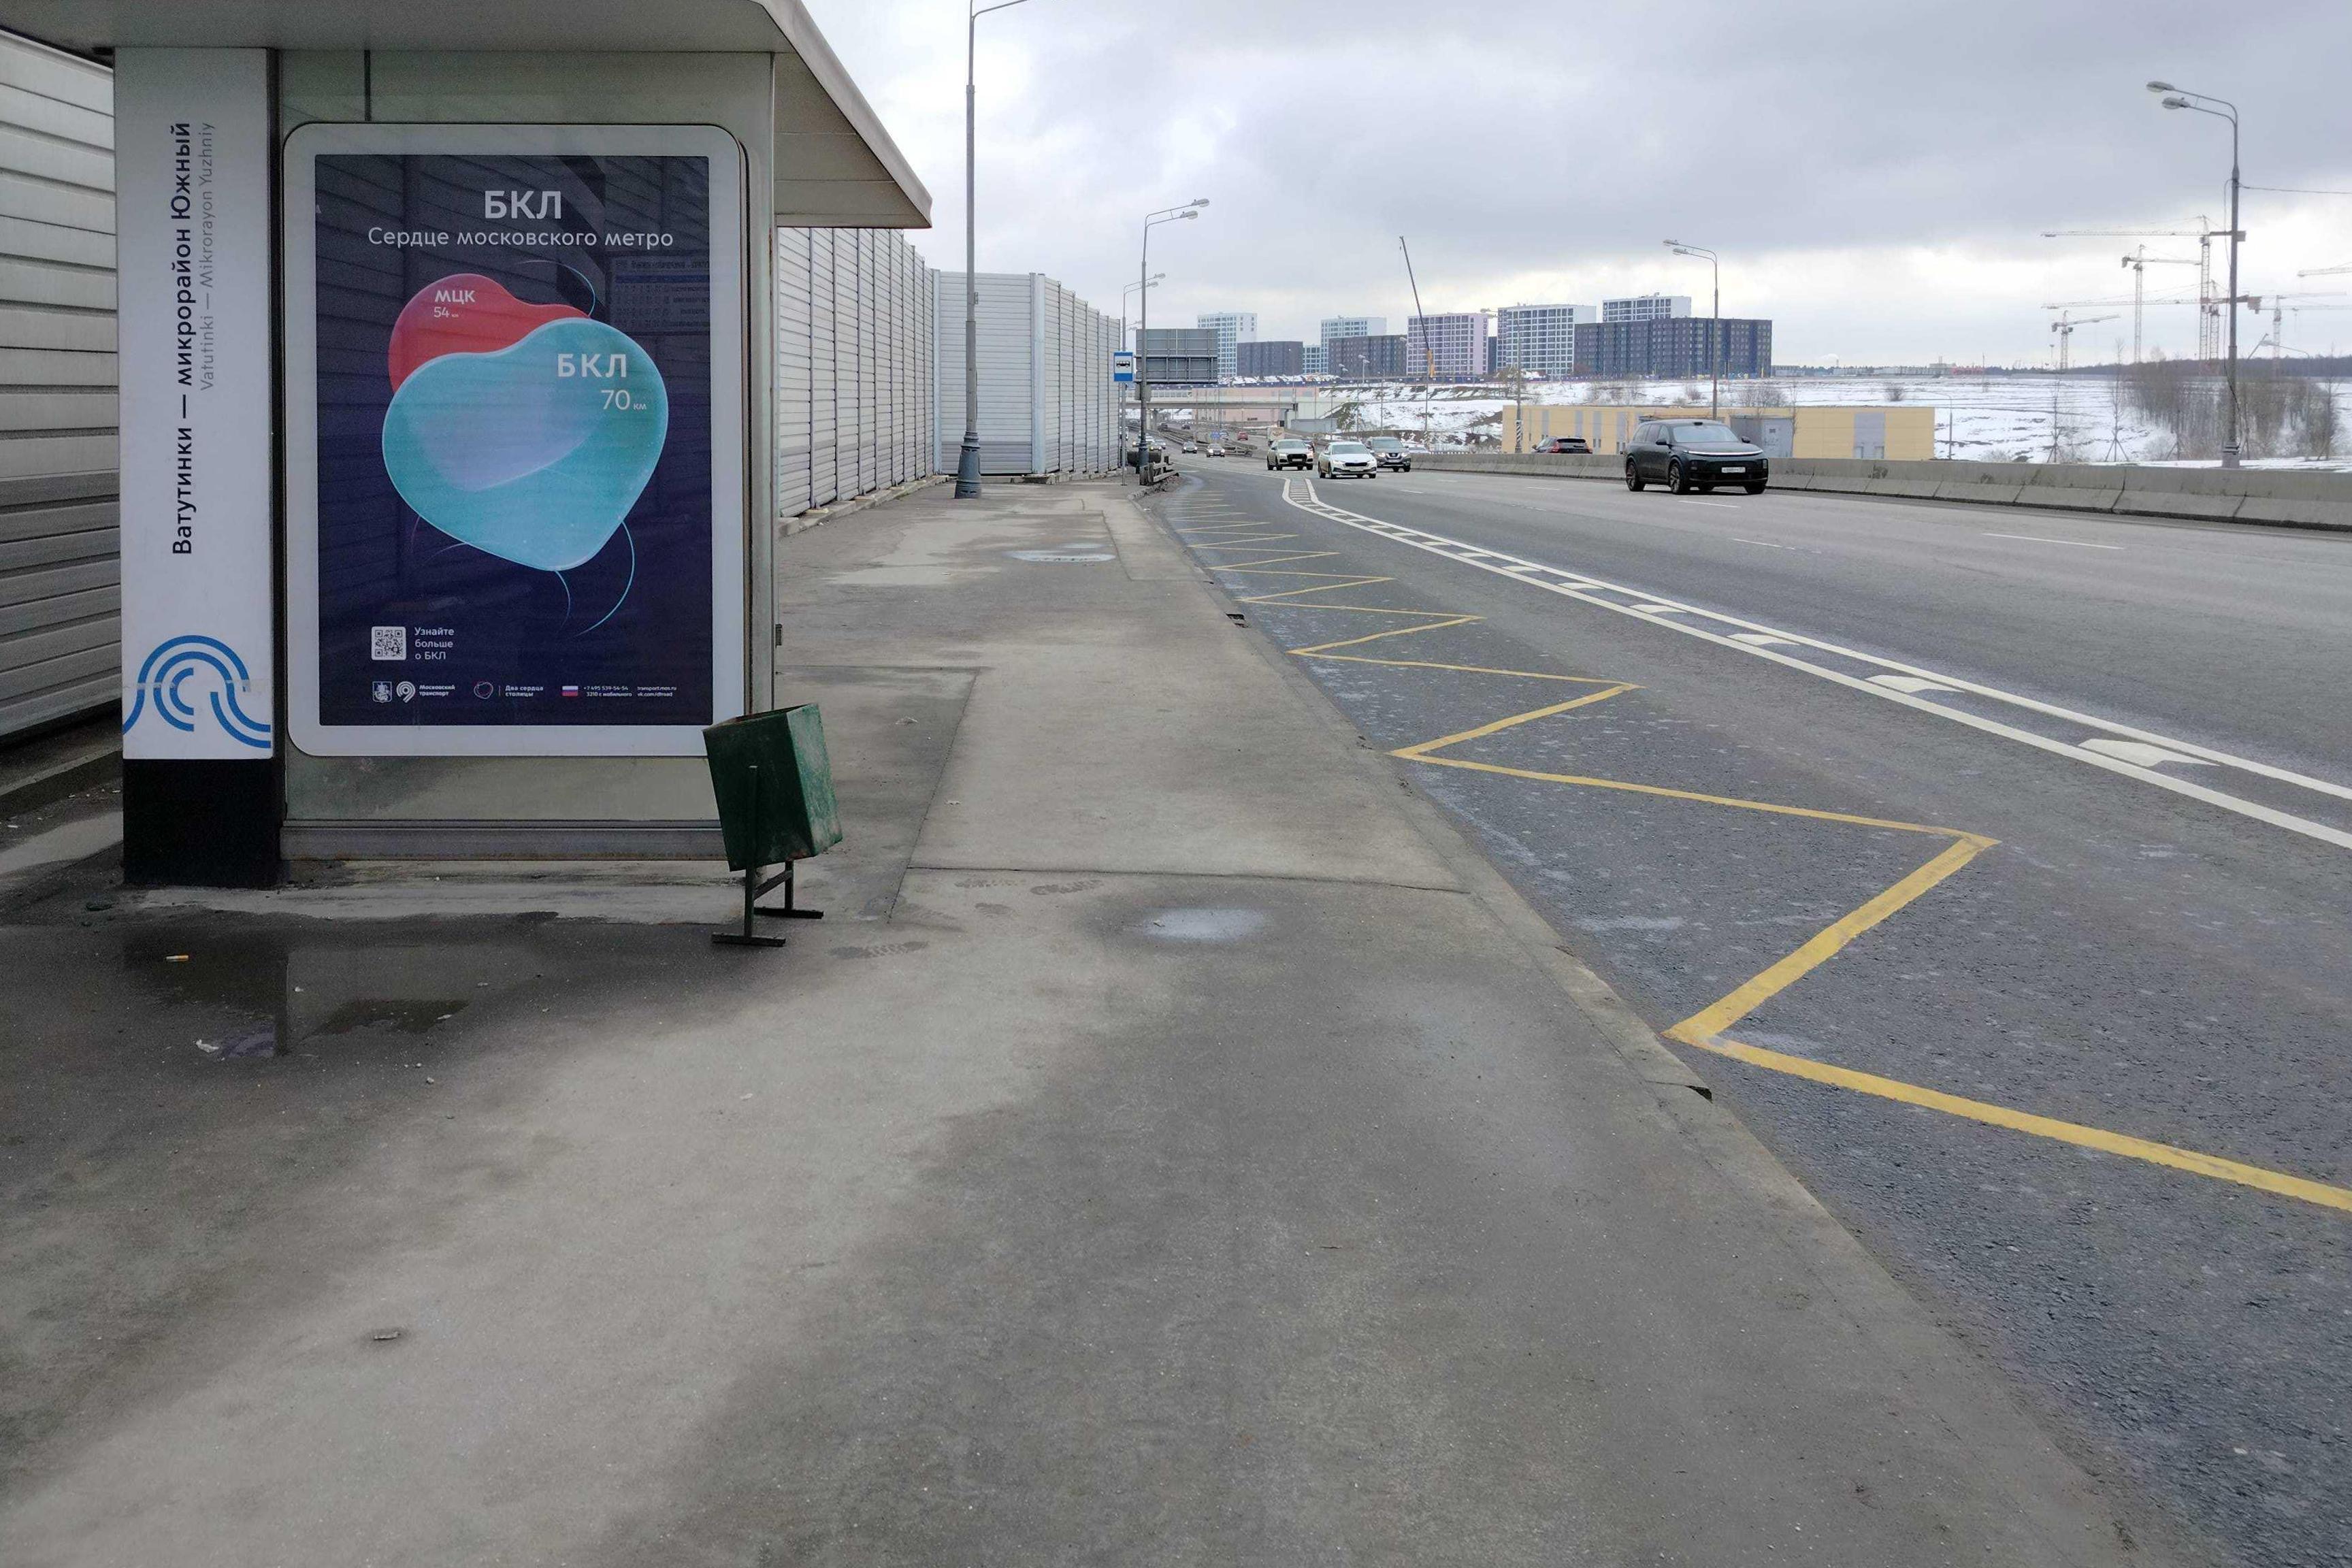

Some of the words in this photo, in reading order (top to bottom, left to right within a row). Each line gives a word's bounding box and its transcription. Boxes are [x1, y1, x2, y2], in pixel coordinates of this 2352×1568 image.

[198, 122, 216, 186] Yuzhniy
[170, 122, 191, 220] Южный
[485, 190, 562, 220] БКЛ
[199, 191, 216, 288] Mikrorayon
[368, 227, 450, 249] Сердце
[457, 232, 598, 246] московского
[604, 233, 674, 250] метро
[172, 229, 197, 386] микрорайон
[434, 290, 476, 304] МЦК
[434, 307, 450, 318] 54
[199, 316, 214, 391] Vatutinki
[557, 353, 627, 378] БКЛ
[601, 389, 631, 410] 70
[172, 427, 197, 555] Ватутинки
[414, 627, 455, 636] Узнайте
[414, 638, 453, 648] больше
[424, 651, 446, 660] БКЛ
